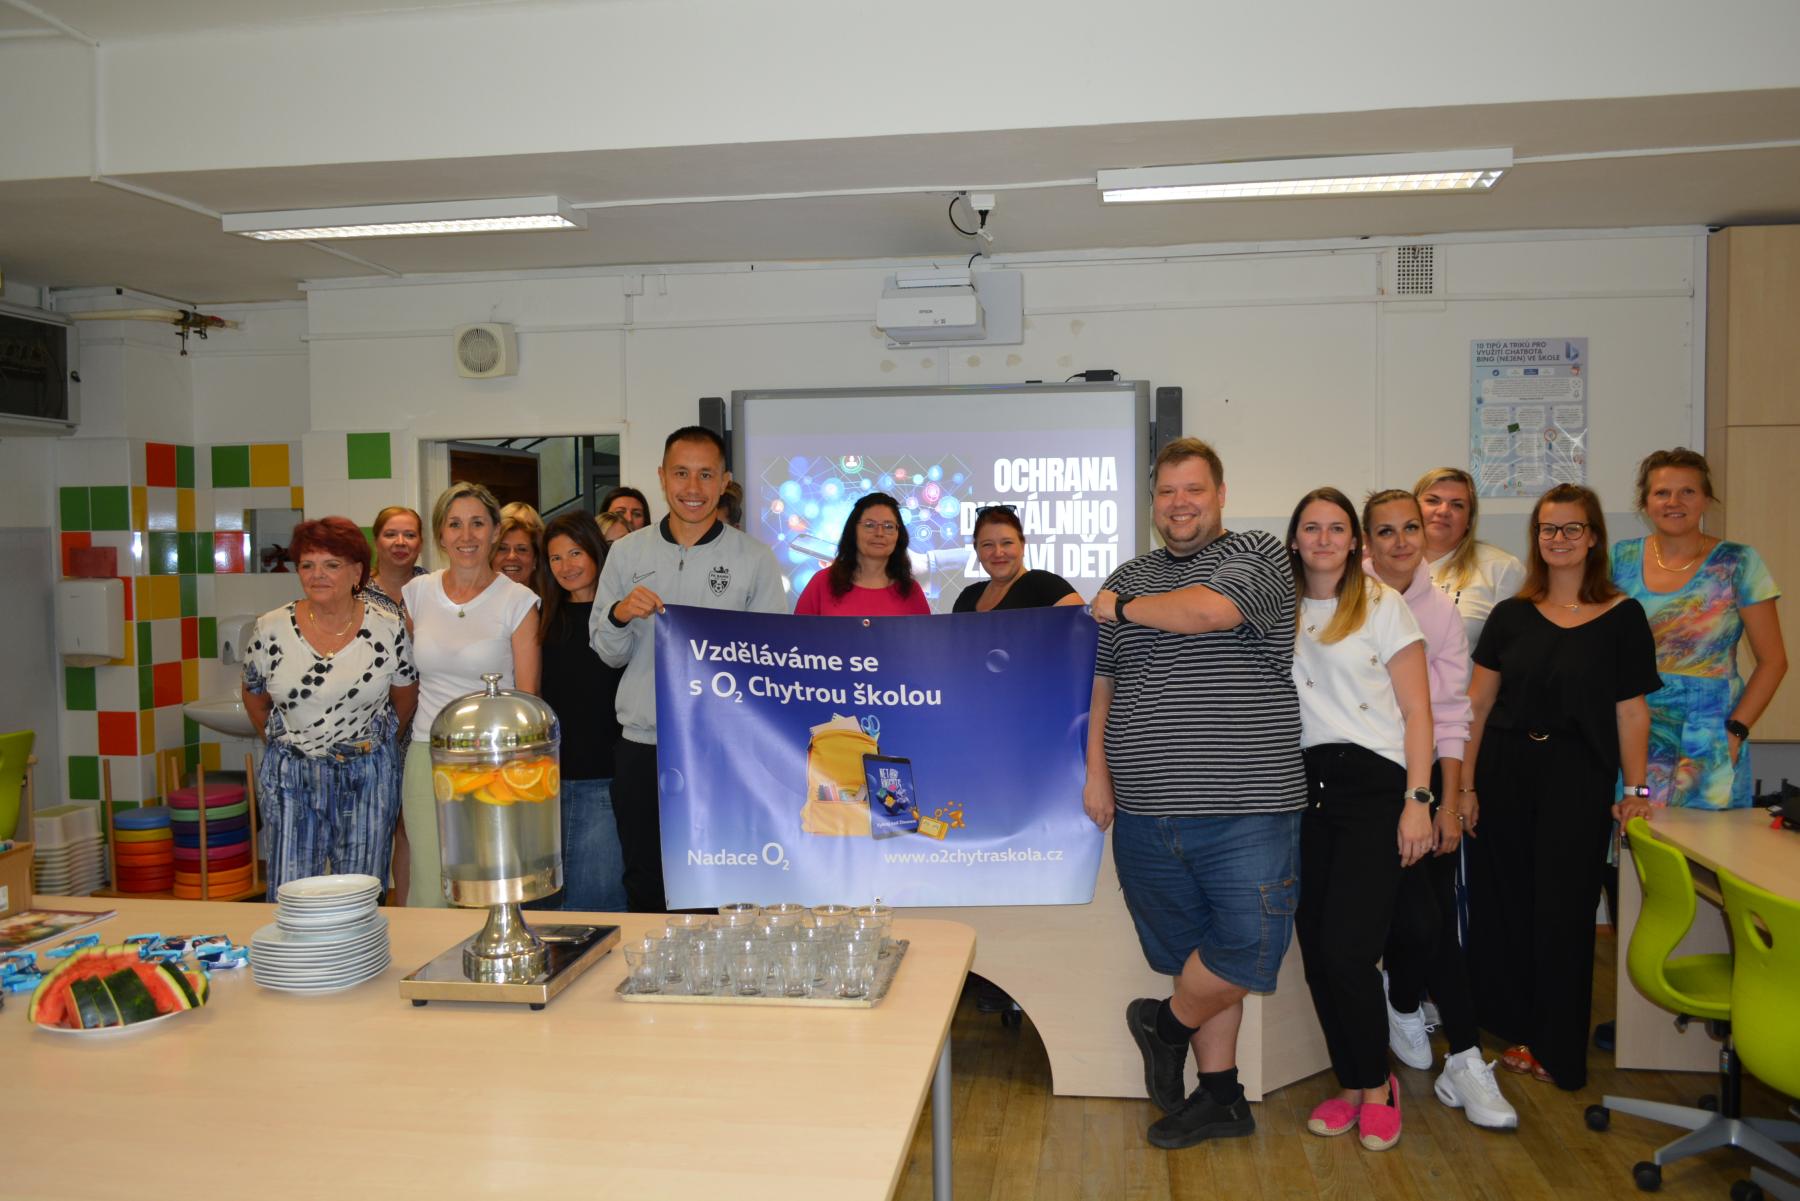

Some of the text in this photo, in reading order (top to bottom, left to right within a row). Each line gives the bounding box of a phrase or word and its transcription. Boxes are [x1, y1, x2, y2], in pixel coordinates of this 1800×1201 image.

[1539, 353, 1561, 361] ŠKOLE
[994, 456, 1118, 492] OCHRANA
[960, 491, 1118, 535] DÁLNÍHO
[1062, 534, 1119, 578] DĚTÍ
[690, 639, 879, 672] Vzděláváme se
[690, 679, 702, 695] s
[748, 675, 847, 704] Chytrou
[854, 682, 942, 706] školou
[687, 849, 758, 866] Nadace
[884, 847, 1063, 867] www.o2chytraskola.cz
